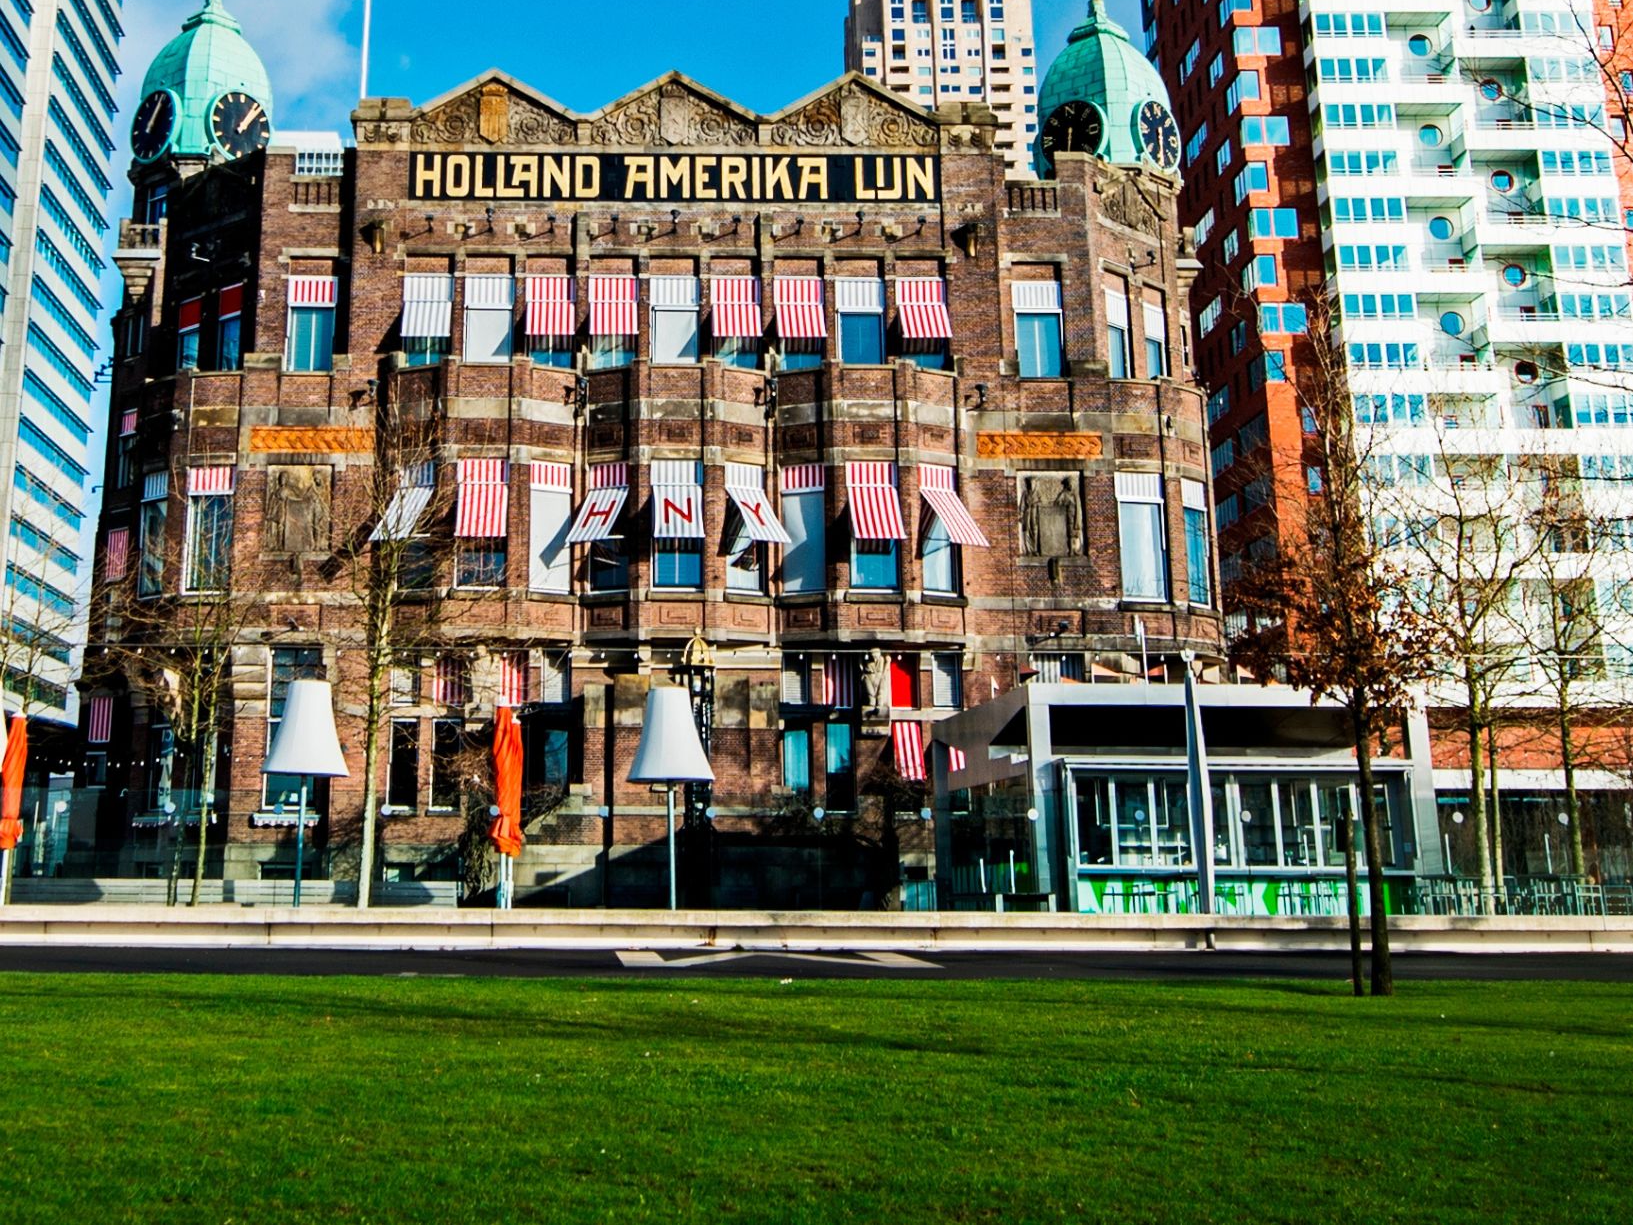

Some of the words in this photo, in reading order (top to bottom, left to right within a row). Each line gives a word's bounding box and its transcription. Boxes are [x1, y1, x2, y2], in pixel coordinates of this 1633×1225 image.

[1065, 104, 1075, 117] N
[415, 155, 601, 198] HOLLAND
[624, 155, 829, 200] AMERIKA
[581, 499, 617, 528] H
[663, 497, 692, 524] N
[739, 500, 766, 526] Y
